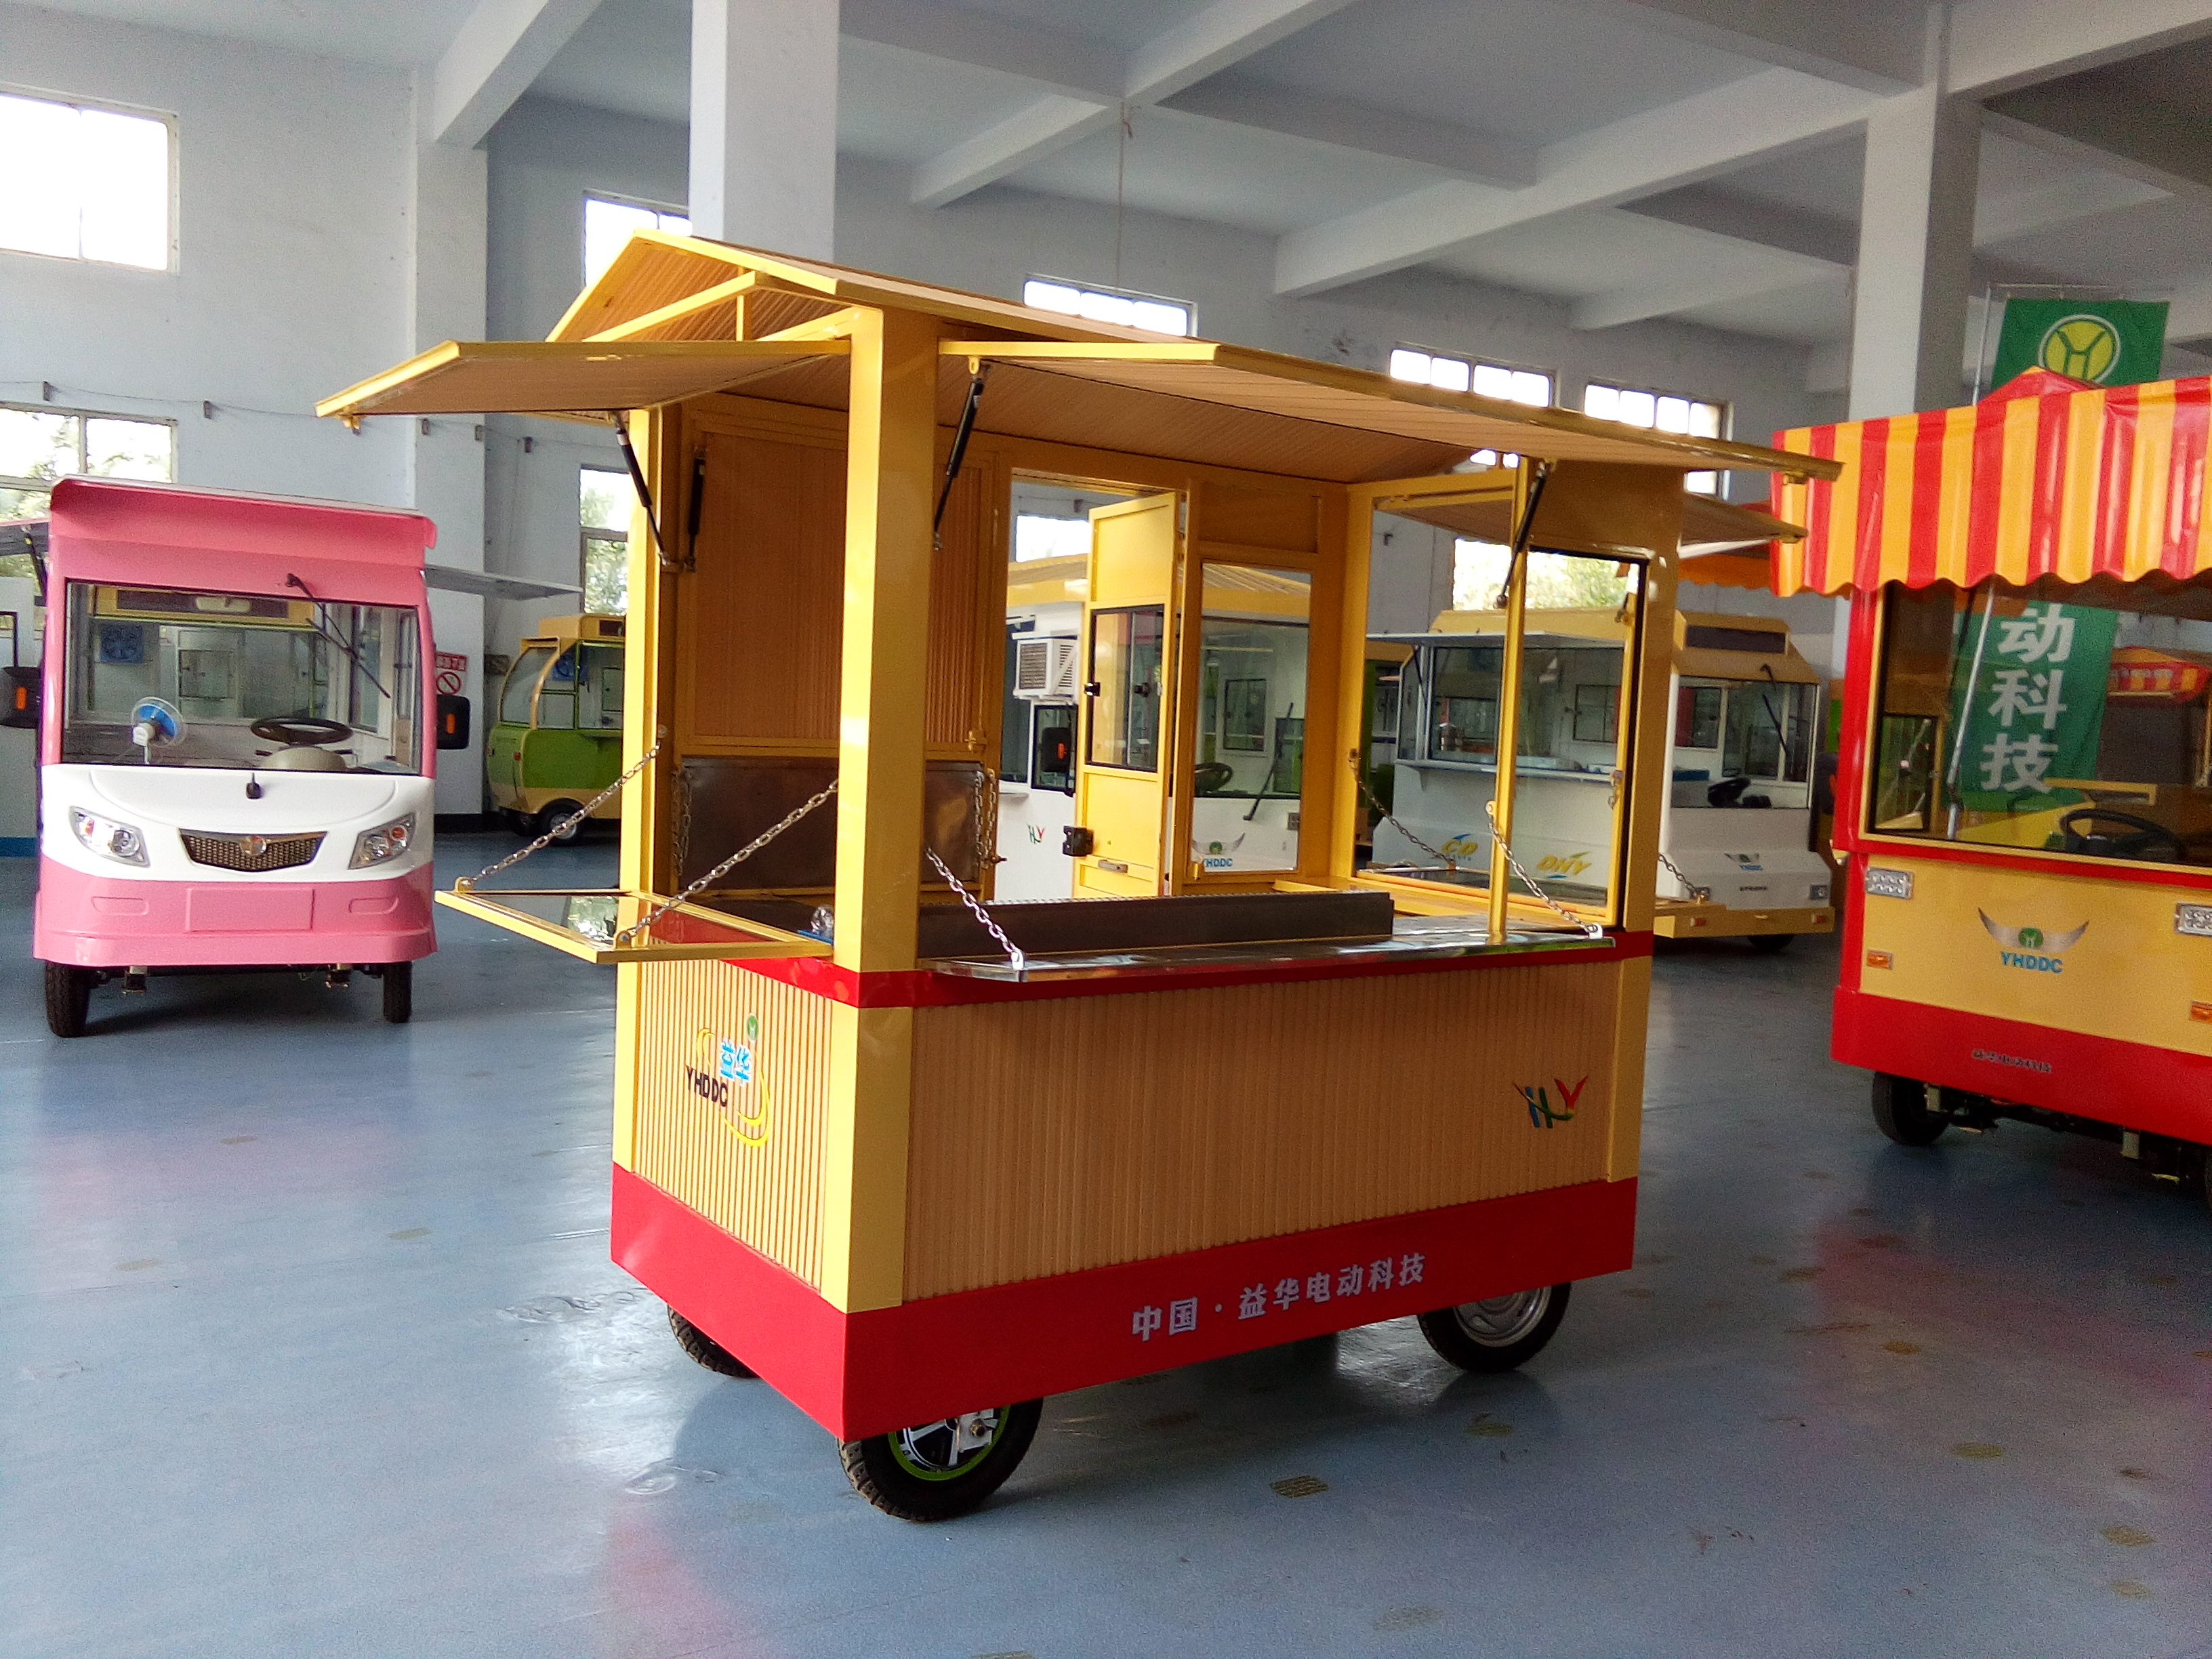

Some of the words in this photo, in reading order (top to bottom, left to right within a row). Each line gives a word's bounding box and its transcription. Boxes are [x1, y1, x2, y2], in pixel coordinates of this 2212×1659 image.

[1980, 602, 2076, 794] 动科技
[2001, 951, 2063, 974] YHDDC
[685, 1065, 729, 1107] YHDDC
